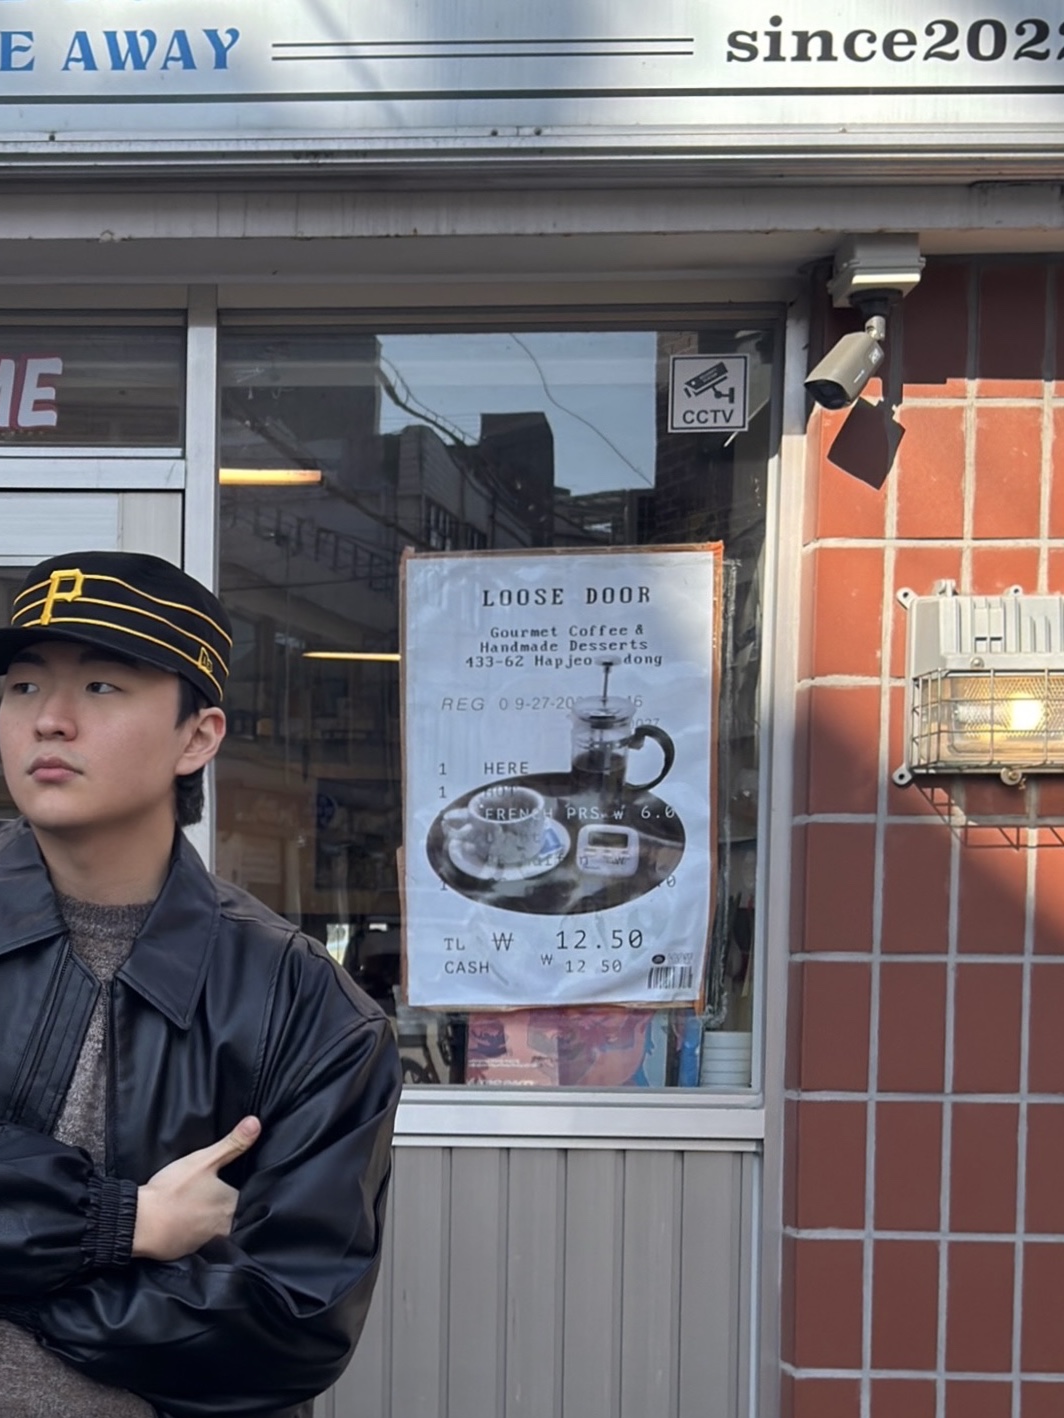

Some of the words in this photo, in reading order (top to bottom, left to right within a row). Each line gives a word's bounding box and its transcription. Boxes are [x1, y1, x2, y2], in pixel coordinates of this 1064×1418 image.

[60, 28, 240, 71] AWAY
[726, 15, 1064, 62] since202
[682, 409, 734, 424] CCTV
[40, 568, 84, 625] P
[483, 588, 565, 607] LOOSE
[586, 586, 651, 605] DOOR
[490, 626, 558, 638] Gourmet
[569, 625, 628, 637] Coffee
[635, 624, 644, 635] &
[480, 640, 558, 653] Handmade
[570, 639, 648, 651] Desserts
[441, 697, 485, 711] REG
[439, 763, 447, 775] 1
[484, 762, 529, 774] HERE
[439, 787, 447, 799] 1
[444, 938, 465, 951] TL
[556, 930, 643, 949] 12.50
[444, 961, 489, 974] CASH
